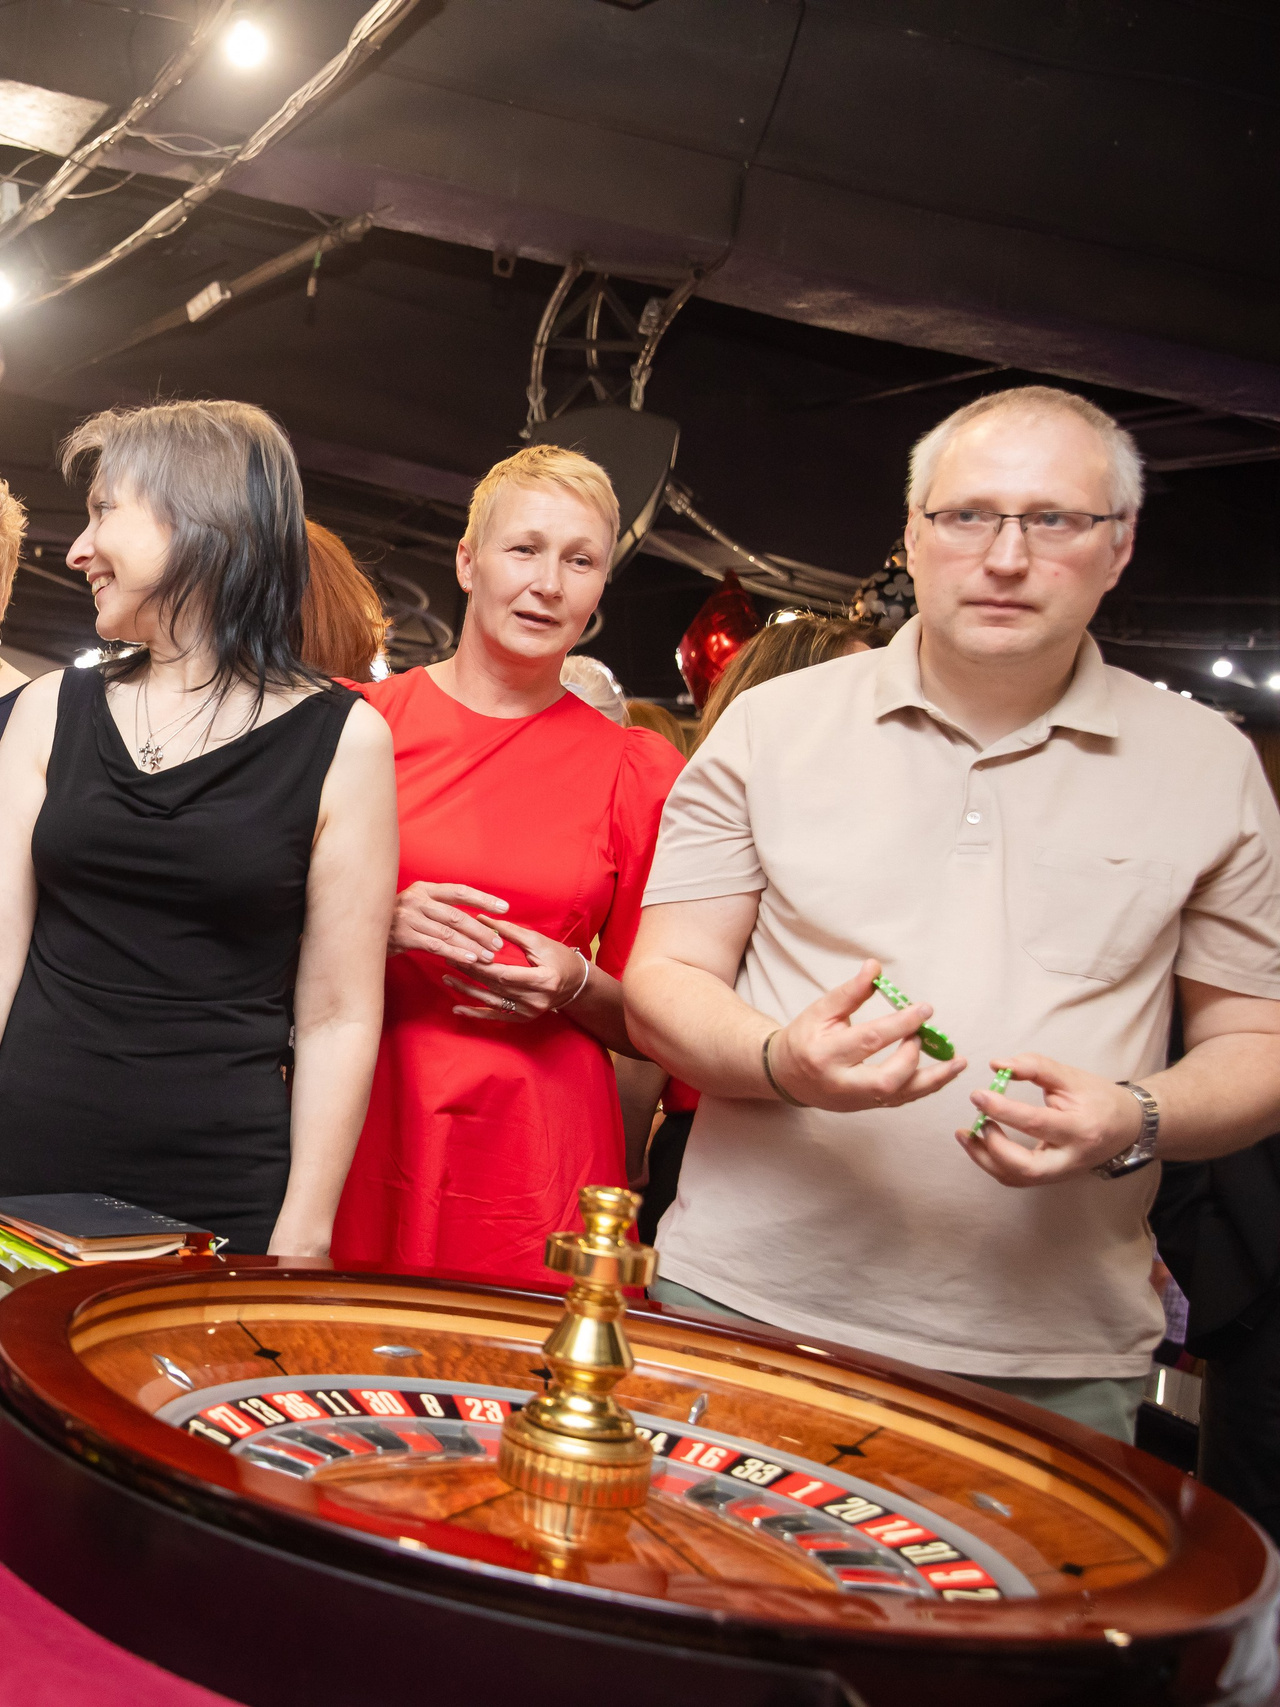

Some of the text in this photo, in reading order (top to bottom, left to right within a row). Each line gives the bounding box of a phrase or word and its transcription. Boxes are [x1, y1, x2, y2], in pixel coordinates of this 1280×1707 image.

[207, 1405, 251, 1435] 27
[238, 1397, 286, 1426] 13
[272, 1392, 321, 1419] 36
[316, 1390, 361, 1416] 11
[361, 1390, 406, 1416] 30
[420, 1393, 445, 1418] 8
[464, 1397, 504, 1424] 23
[680, 1442, 727, 1469] 16
[730, 1457, 784, 1486] 33
[787, 1480, 824, 1500] 1
[823, 1497, 884, 1524] 20
